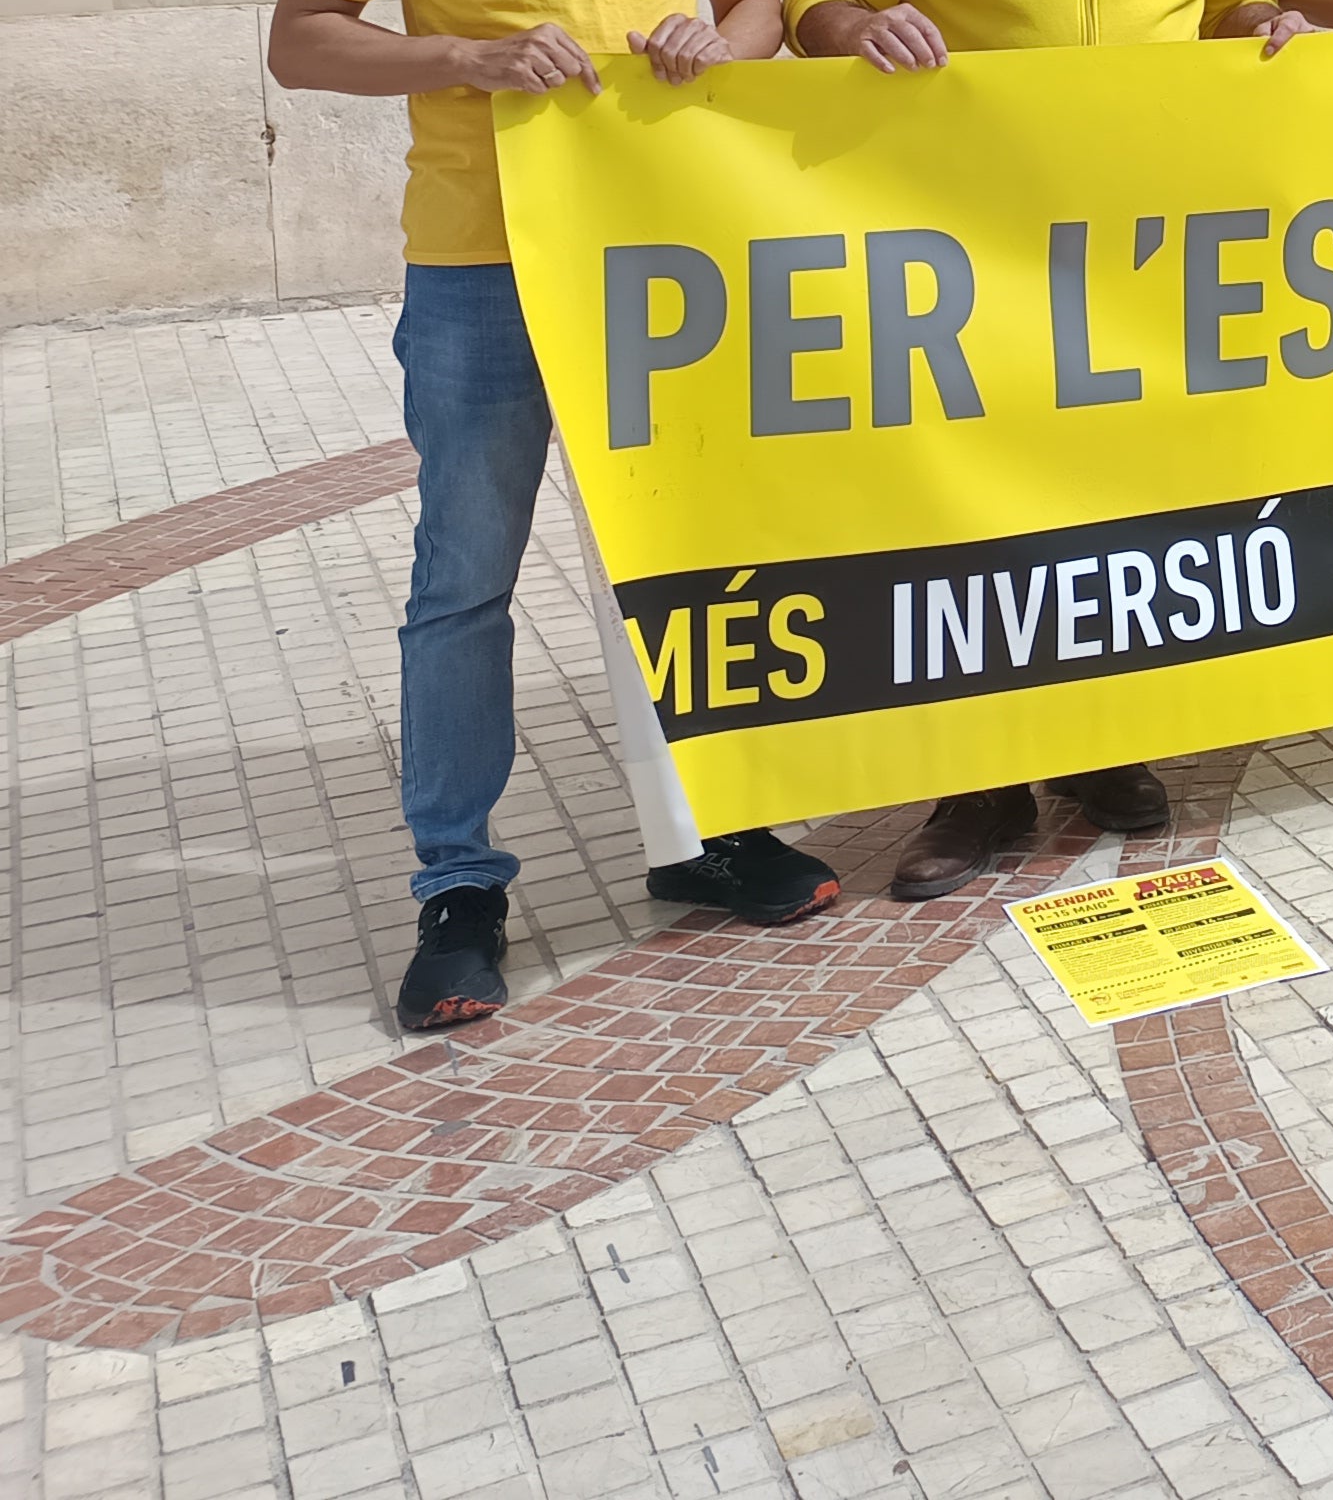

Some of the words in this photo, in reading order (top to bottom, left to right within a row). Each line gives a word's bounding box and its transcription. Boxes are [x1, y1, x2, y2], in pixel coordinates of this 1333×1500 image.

[602, 227, 986, 451] PER
[624, 568, 827, 715] MÉS
[892, 496, 1297, 685] INVERSIÓ
[1152, 871, 1202, 888] VAGA
[1022, 888, 1116, 914] CALENDARI
[1029, 908, 1070, 923] 11-15
[1072, 901, 1108, 914] MAIG
[1084, 916, 1098, 924] 11
[1098, 931, 1114, 940] 12
